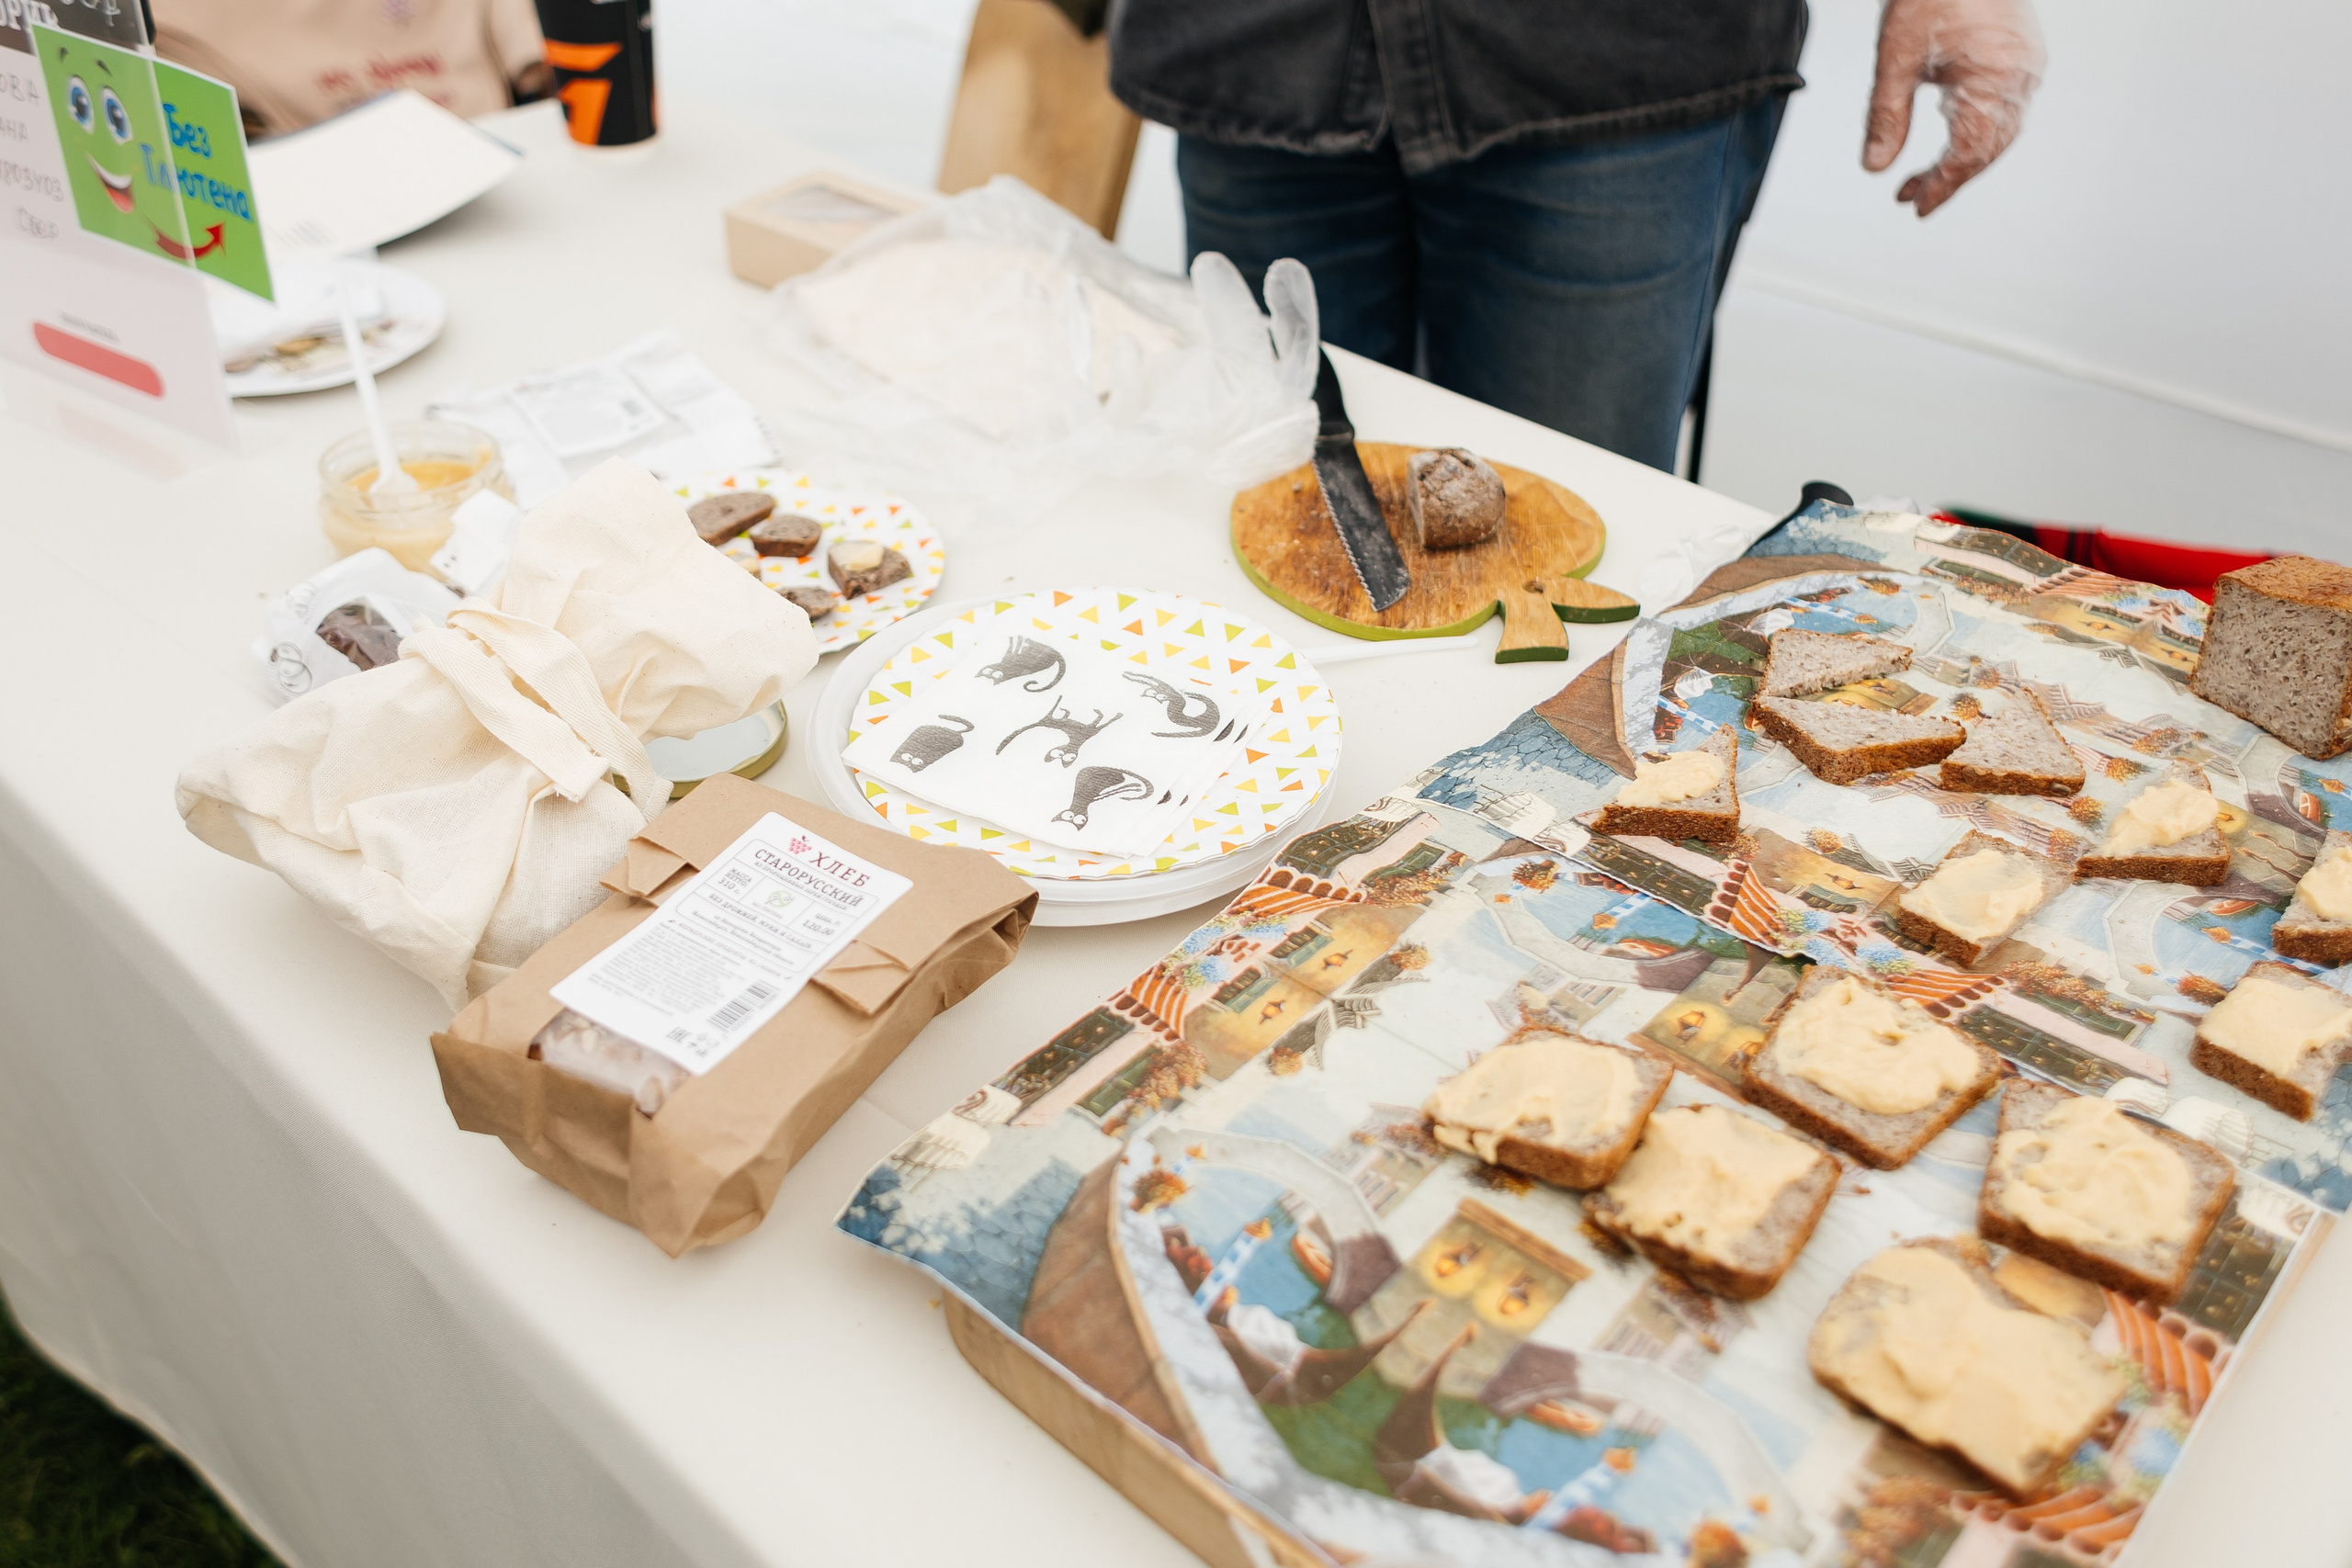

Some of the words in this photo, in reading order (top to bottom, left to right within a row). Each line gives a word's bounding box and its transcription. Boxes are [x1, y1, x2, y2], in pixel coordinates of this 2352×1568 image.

[163, 103, 212, 159] Без
[729, 867, 752, 883] МАССА
[808, 851, 870, 886] ХЛЕБ
[717, 876, 736, 890] 310
[724, 871, 748, 887] НЕТТО:
[753, 848, 864, 907] СТАРОРУССКИЙ
[801, 919, 835, 936] 120.00
